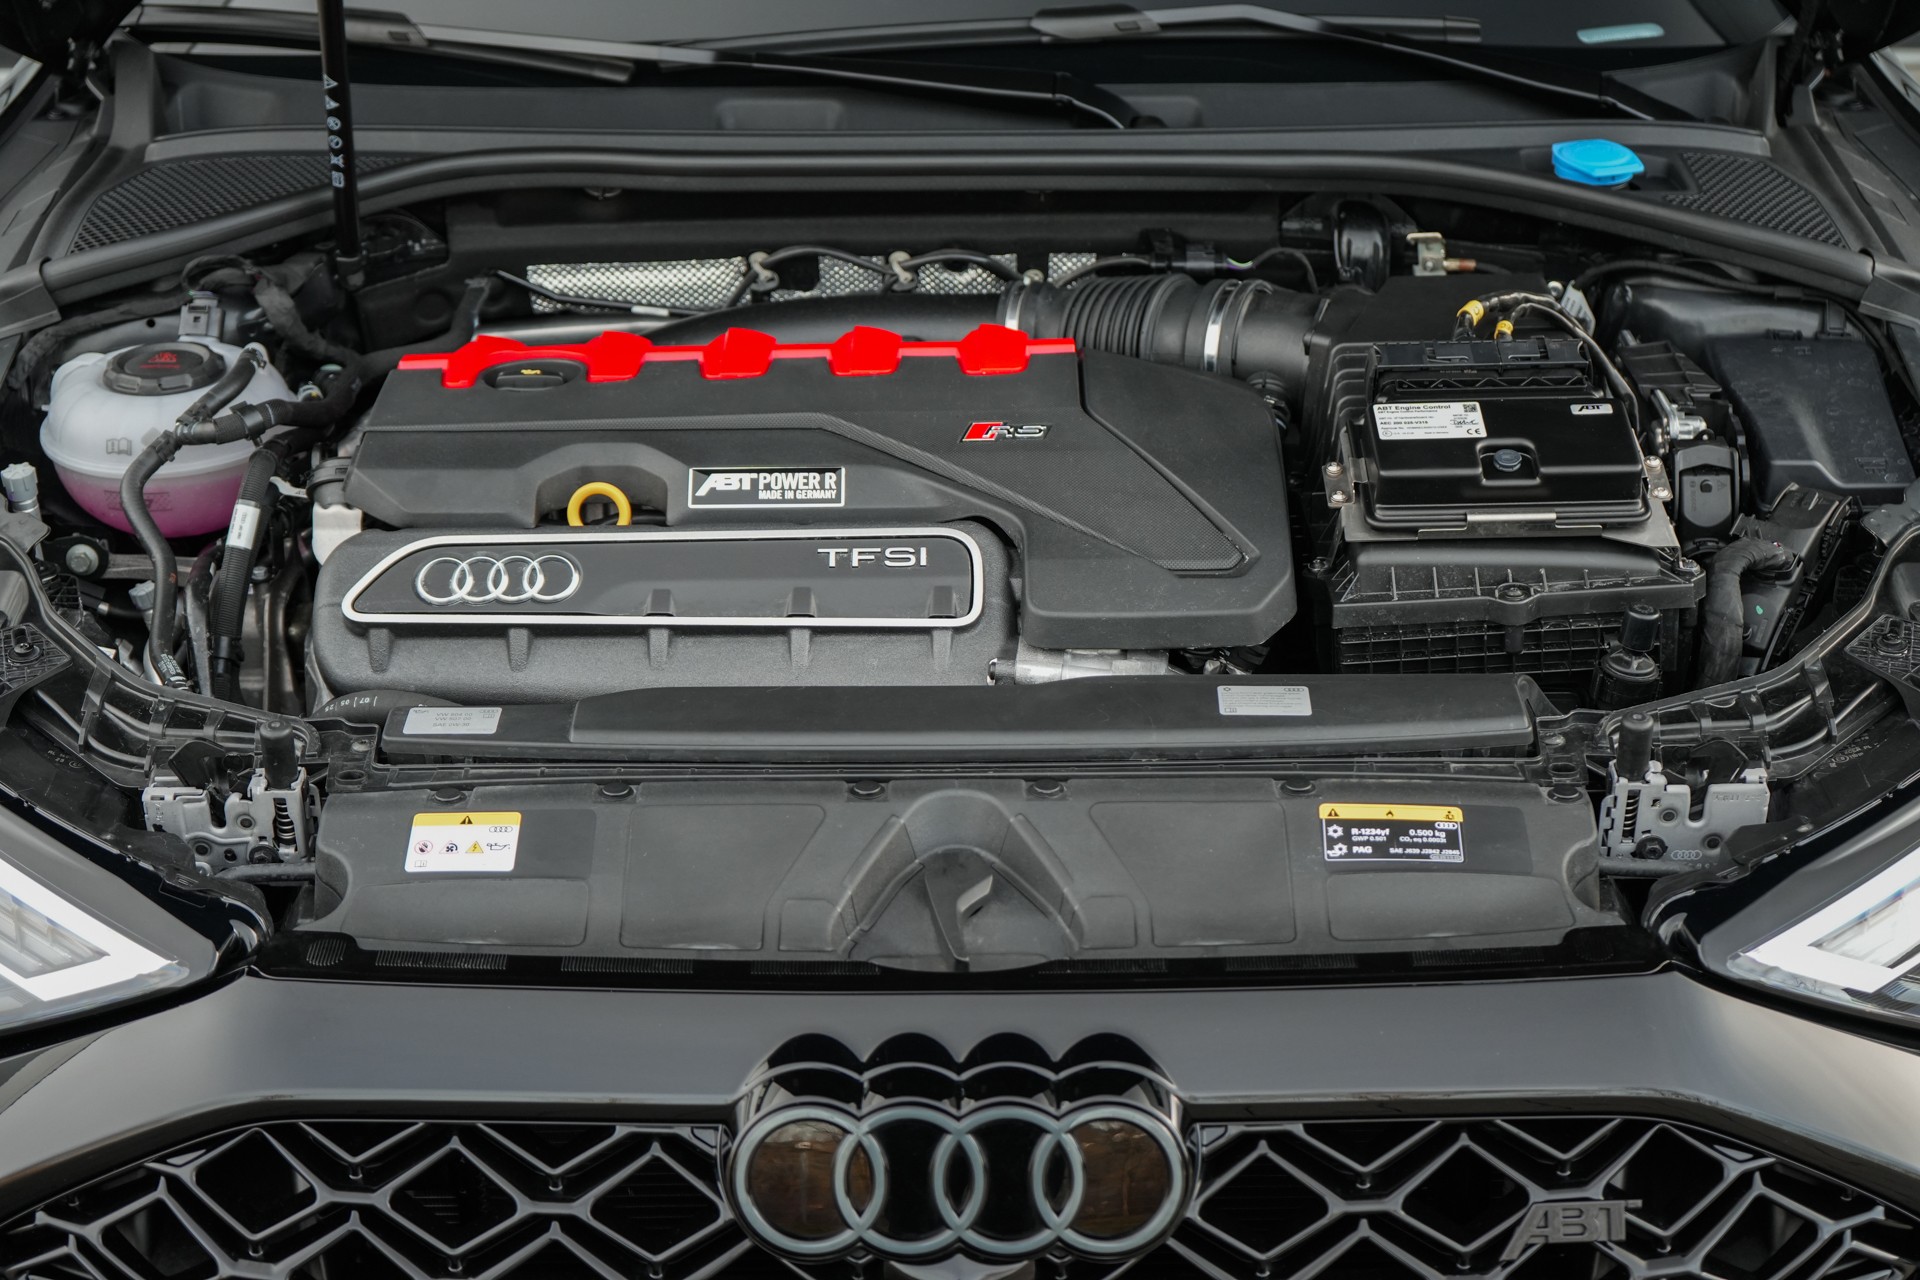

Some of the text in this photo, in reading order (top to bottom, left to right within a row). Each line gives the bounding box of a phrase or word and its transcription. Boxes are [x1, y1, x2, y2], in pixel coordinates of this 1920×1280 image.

[1578, 404, 1603, 413] ABT
[695, 472, 837, 496] ABT POWER R
[758, 489, 837, 500] MADE IN GERMANY
[817, 546, 927, 567] TFSI
[1351, 828, 1390, 837] R-1234yf
[1408, 829, 1446, 838] 0.500 kg
[1352, 846, 1373, 854] PAG
[1404, 847, 1420, 855] J639
[1499, 1200, 1643, 1262] ABT
